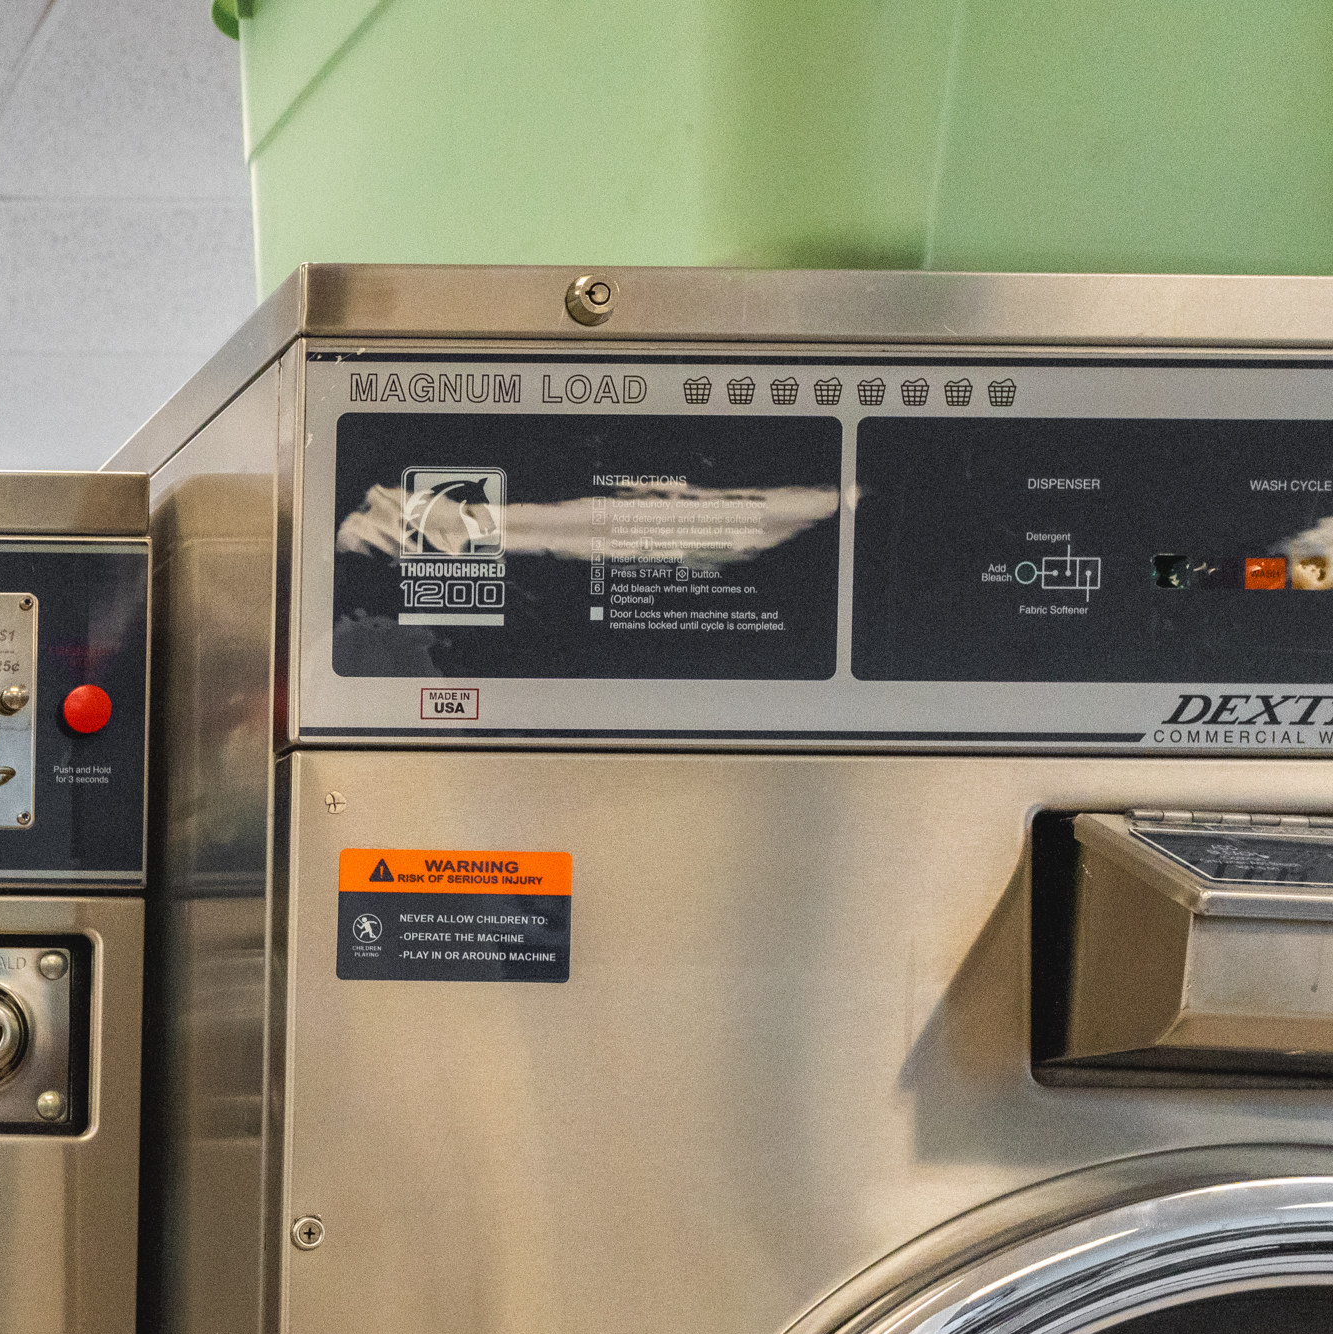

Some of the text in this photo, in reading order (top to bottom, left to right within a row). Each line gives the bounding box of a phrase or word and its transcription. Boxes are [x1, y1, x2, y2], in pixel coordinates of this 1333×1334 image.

[350, 373, 648, 404] MAGNUM LOAD
[592, 475, 687, 486] INSTRUCTIONS
[1027, 478, 1101, 490] DISPENSER
[1250, 480, 1332, 491] WASH CYCLE
[1026, 532, 1071, 543] Detergent
[400, 562, 505, 578] THOROUGHBRED
[987, 564, 1006, 573] Add
[981, 573, 1012, 582] Bleach
[399, 580, 505, 608] 1200
[1019, 605, 1089, 615] Fabric Softener
[429, 691, 470, 701] MADE IN
[433, 702, 465, 714] USA
[1161, 695, 1333, 725] DEXT
[1153, 730, 1305, 744] COMMERCIAL
[53, 765, 112, 774] Push and Hold
[55, 774, 109, 784] for 3 seconds
[424, 859, 519, 874] WARNING
[398, 874, 543, 885] RISK OF SERIOUS INJURY
[399, 914, 548, 925] NEVER ALLOW CHILDREN TO:
